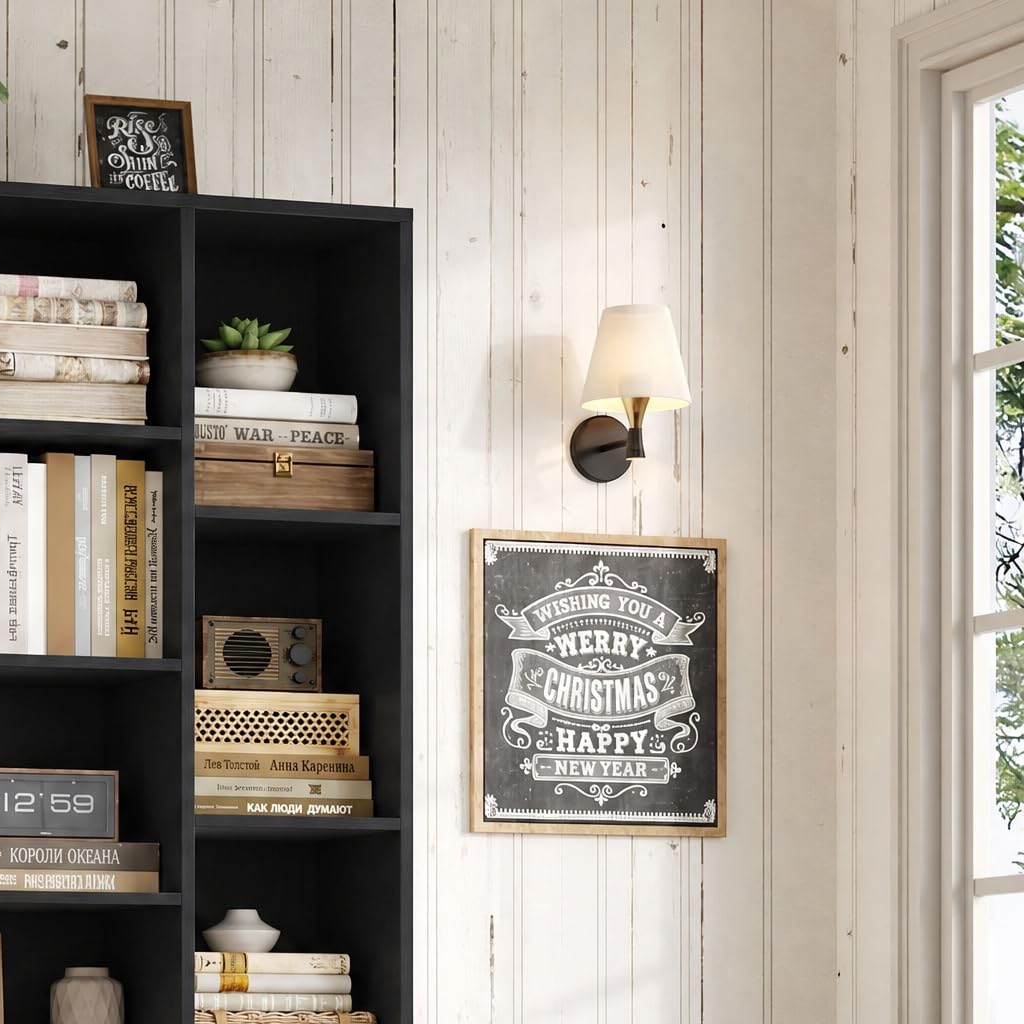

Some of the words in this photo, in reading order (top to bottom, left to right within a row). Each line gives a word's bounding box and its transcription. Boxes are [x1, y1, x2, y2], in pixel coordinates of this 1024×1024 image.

[233, 427, 274, 442] WAR
[533, 594, 611, 623] WISHING
[618, 598, 653, 619] YOU
[653, 613, 666, 628] A
[543, 667, 660, 714] CHRISTMAS
[556, 727, 648, 754] HAPPY
[204, 759, 222, 769] Лев
[224, 760, 260, 770] Толстой
[270, 760, 299, 771] Анна
[555, 760, 596, 776] NEW
[600, 761, 647, 778] YEAR
[247, 802, 268, 813] КАК
[271, 803, 303, 814] ЛЮДИ
[307, 804, 353, 815] ДУМАЮТ
[10, 847, 63, 864] КОРОЛИ
[67, 848, 120, 865] ОКЕАНА
